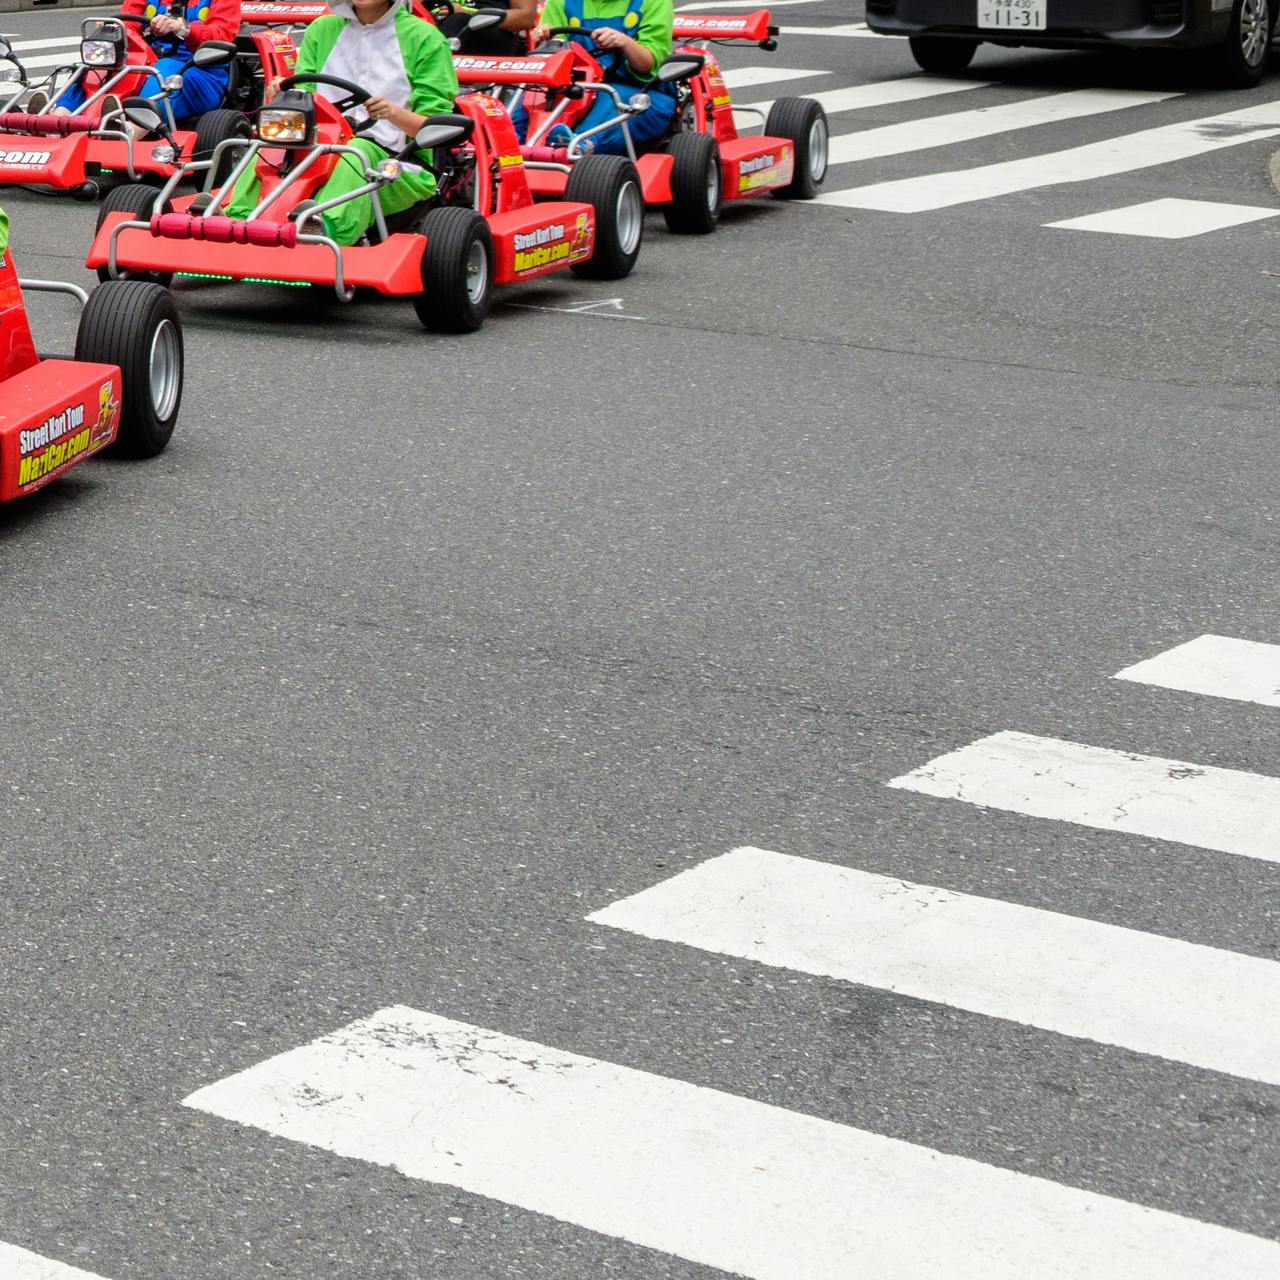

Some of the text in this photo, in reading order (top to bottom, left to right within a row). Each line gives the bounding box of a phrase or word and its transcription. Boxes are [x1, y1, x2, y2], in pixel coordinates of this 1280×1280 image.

[673, 17, 748, 29] Car.com
[995, 9, 1040, 27] 11-31
[19, 403, 85, 455] Street Kart Tour
[18, 428, 91, 487] MariCar.com
